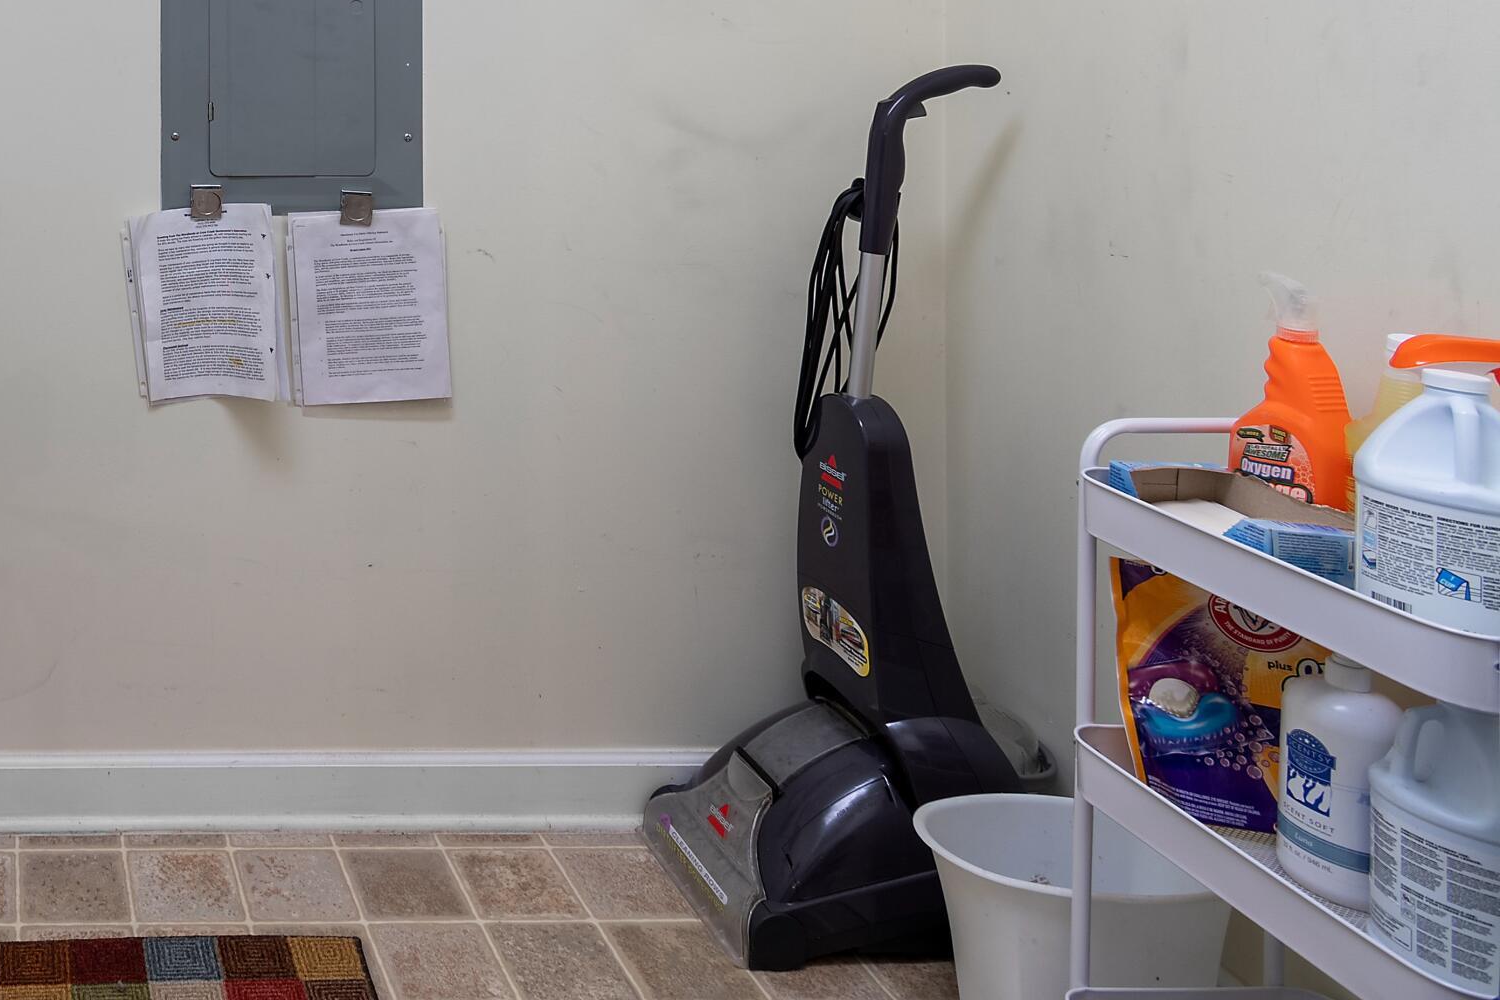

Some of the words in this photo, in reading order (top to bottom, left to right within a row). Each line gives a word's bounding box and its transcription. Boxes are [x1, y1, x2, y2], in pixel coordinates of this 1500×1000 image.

[1244, 446, 1287, 461] AWESOME
[1241, 457, 1292, 480] Oxygen
[818, 483, 843, 507] POWER
[1232, 628, 1266, 646] STANDARD
[1267, 660, 1292, 672] plus
[1283, 800, 1306, 822] SCENT
[1308, 818, 1336, 834] SOFT
[1294, 832, 1314, 847] Luna
[671, 830, 703, 873] CLEANING
[703, 873, 726, 901] ROWS
